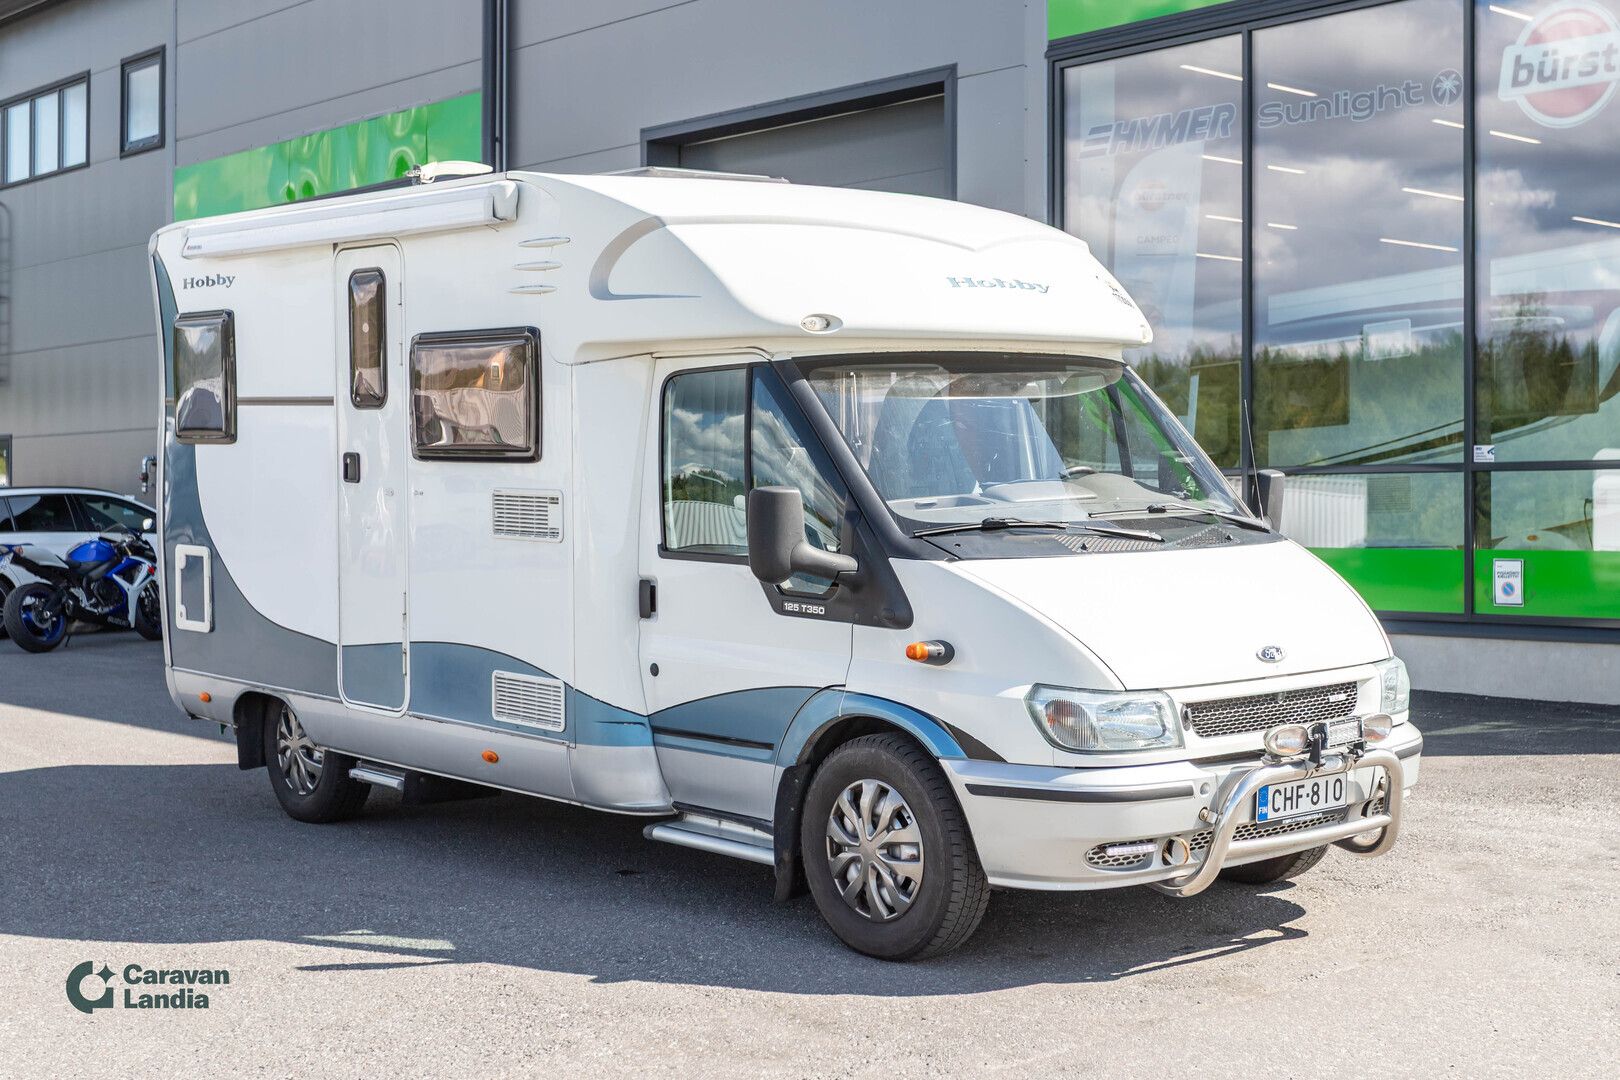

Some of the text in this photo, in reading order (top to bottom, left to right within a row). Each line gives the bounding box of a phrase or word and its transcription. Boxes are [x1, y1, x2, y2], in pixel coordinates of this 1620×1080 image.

[1257, 80, 1424, 128] Sunlight
[1108, 103, 1237, 156] HYMER
[183, 273, 236, 290] Hobby
[946, 277, 1050, 294] Hobby
[784, 602, 825, 614] 125 T350
[1272, 778, 1343, 813] CHF-810
[1258, 806, 1268, 815] FIN
